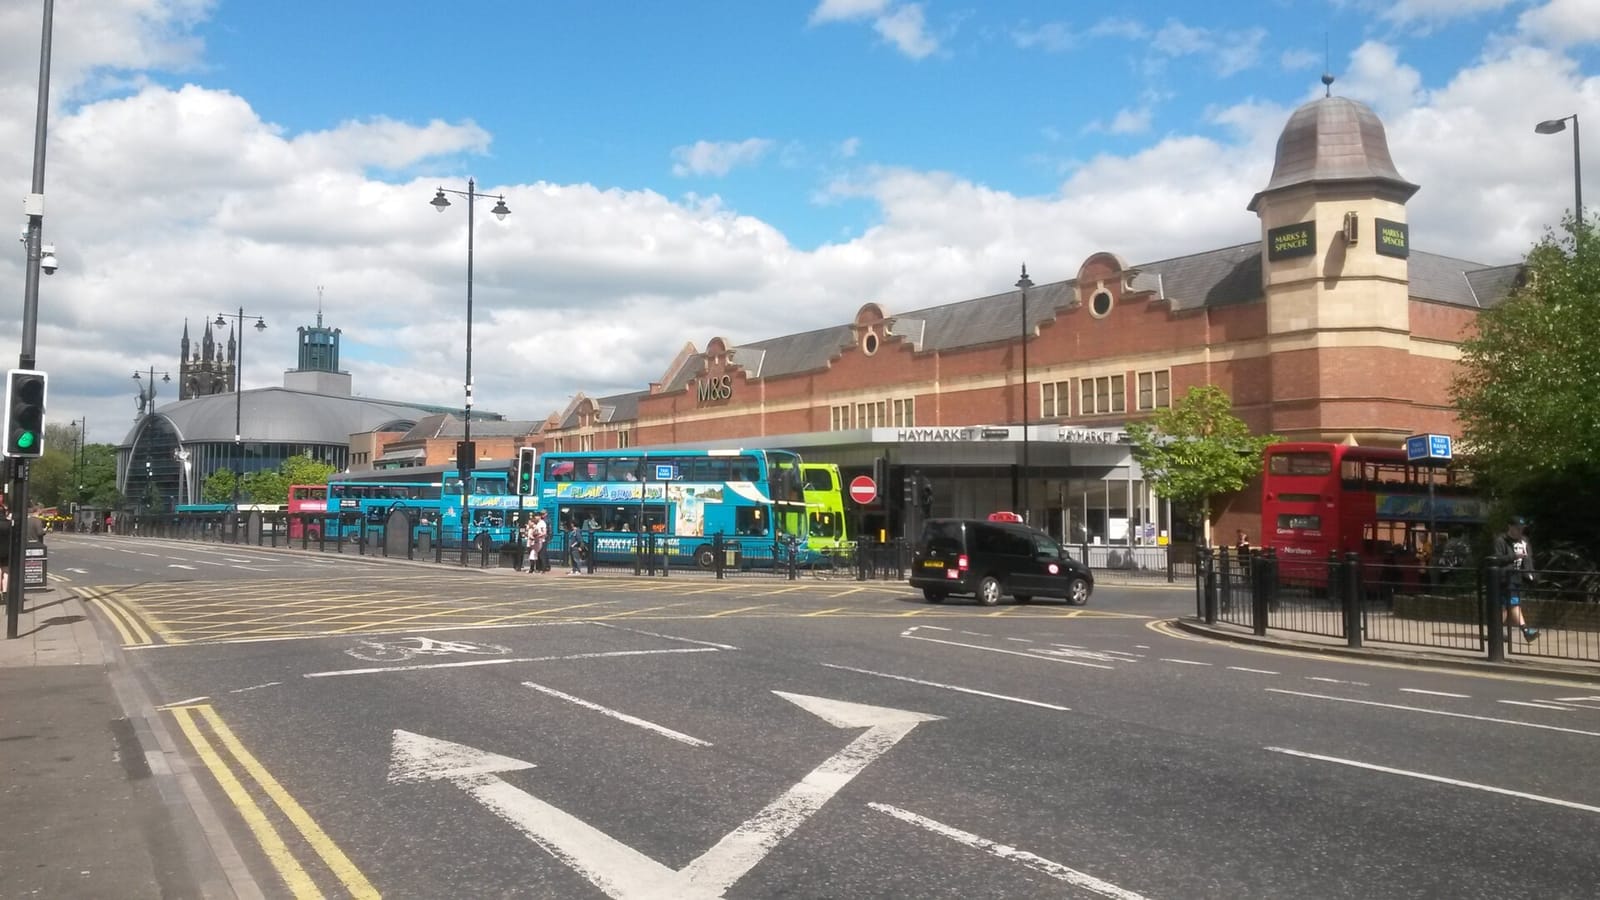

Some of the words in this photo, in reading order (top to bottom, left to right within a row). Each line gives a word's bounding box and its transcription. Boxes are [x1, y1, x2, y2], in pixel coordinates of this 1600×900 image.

[1275, 232, 1300, 243] MARKS
[1301, 231, 1308, 239] &
[1382, 227, 1400, 239] MARKS
[1275, 239, 1308, 251] SPENCER
[1382, 235, 1405, 247] SPENCER
[697, 375, 731, 401] M&S
[898, 429, 975, 441] HAYMARKET
[1058, 430, 1113, 441] HAYMARKET
[1284, 546, 1312, 555] Northern
